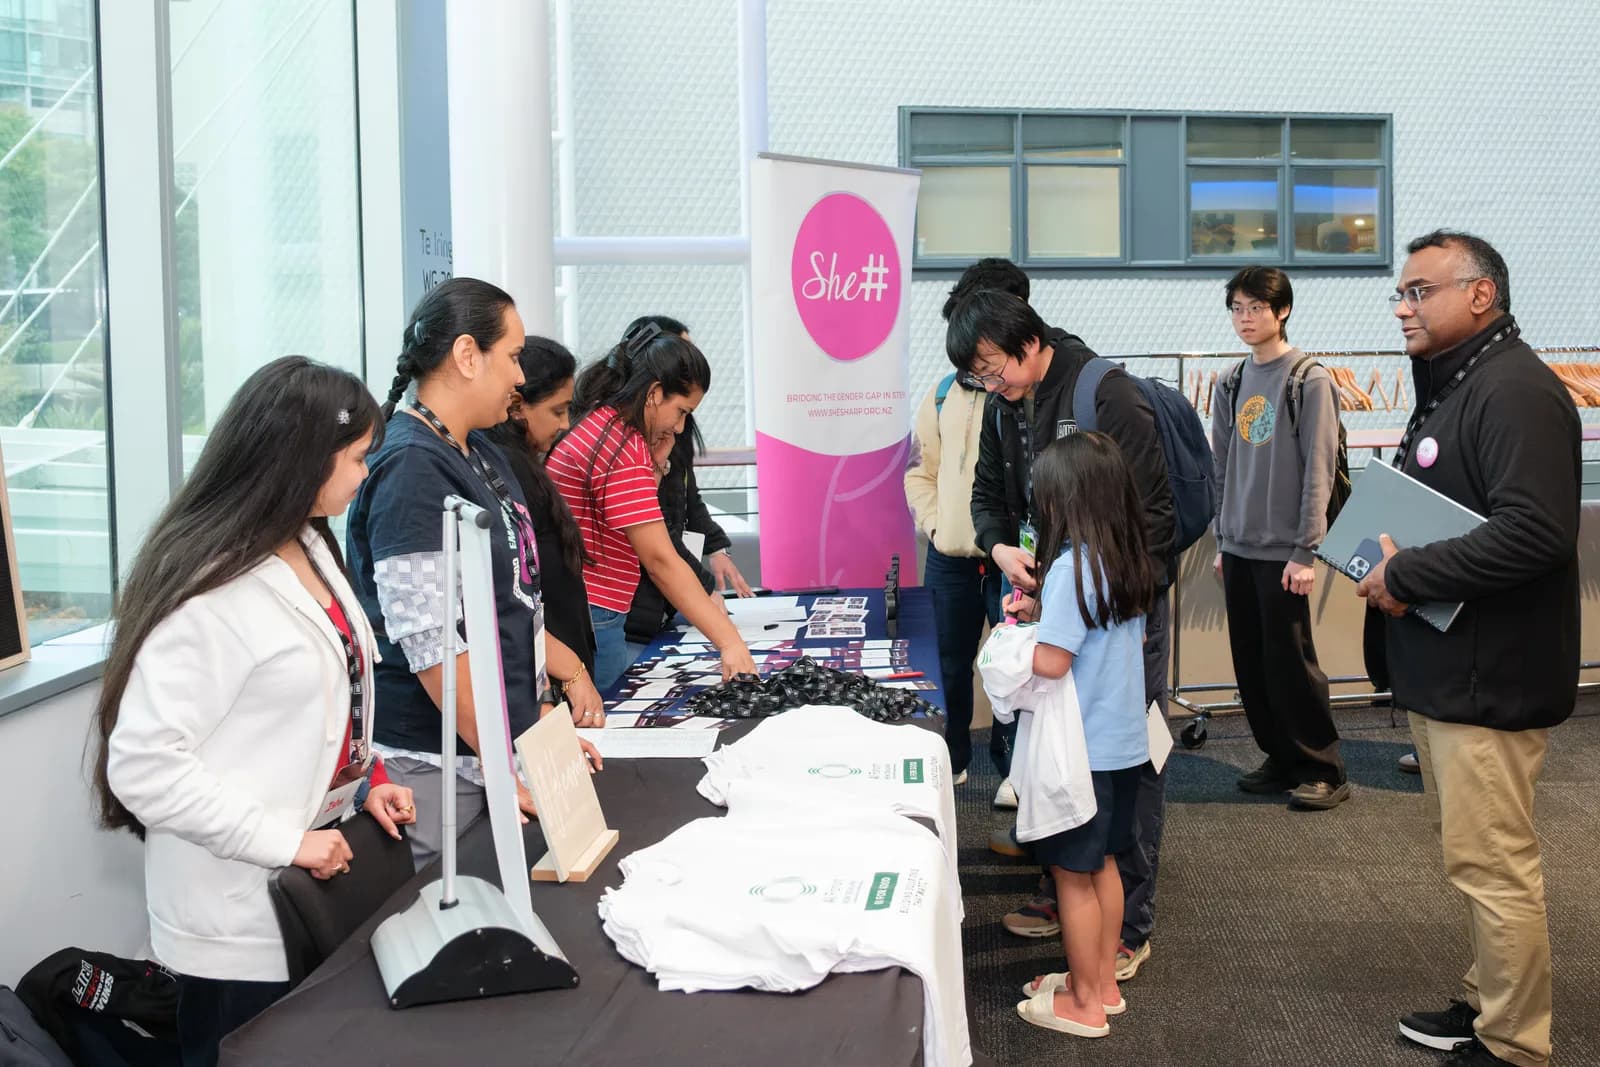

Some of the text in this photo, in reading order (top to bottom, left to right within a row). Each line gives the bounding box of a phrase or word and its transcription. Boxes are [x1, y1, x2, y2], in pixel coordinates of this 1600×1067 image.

[419, 228, 431, 255] Te
[786, 393, 822, 402] BRIDGING
[824, 393, 836, 401] THE
[836, 392, 864, 401] GENDER
[865, 391, 881, 400] GAP
[883, 391, 891, 400] IN
[807, 406, 893, 417] WWW.SHESHARP.ORG.NZ
